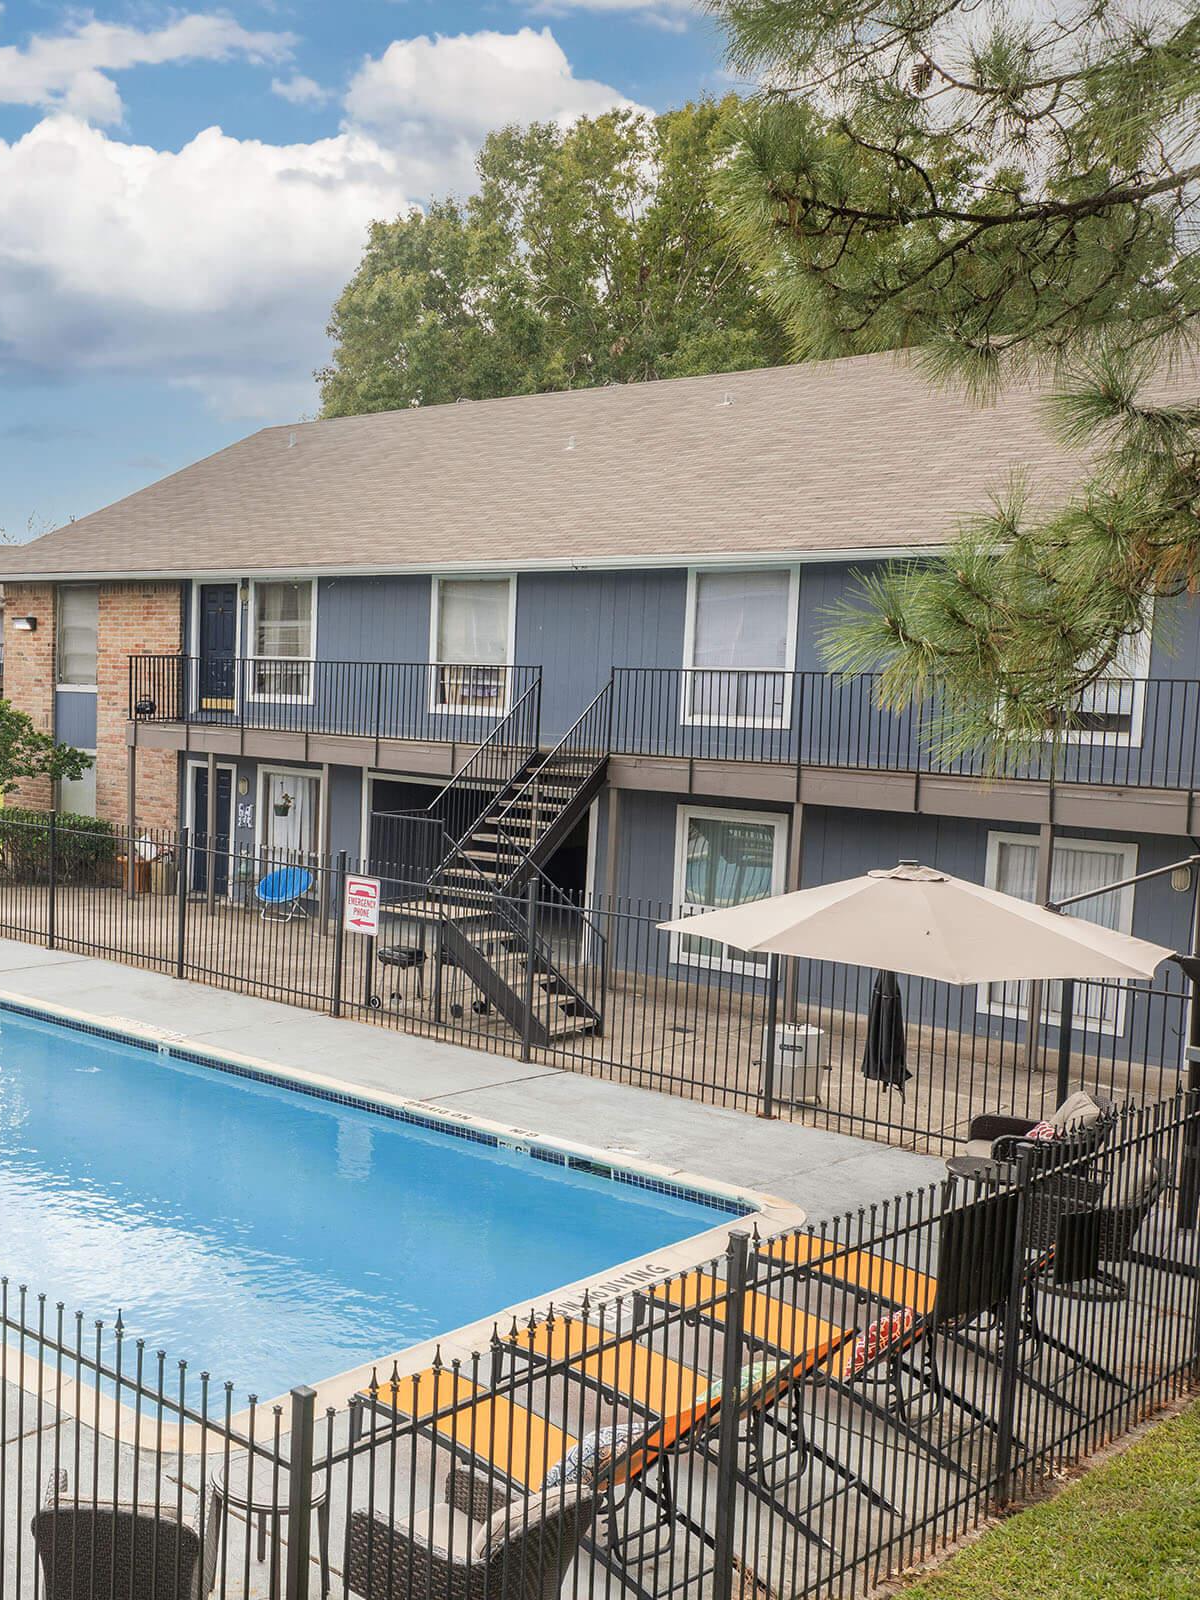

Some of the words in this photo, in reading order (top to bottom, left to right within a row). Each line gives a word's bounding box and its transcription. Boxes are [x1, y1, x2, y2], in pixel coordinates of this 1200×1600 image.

[348, 896, 376, 909] EMERGENCY
[352, 906, 370, 918] PHONE
[607, 1263, 672, 1293] DIVING
